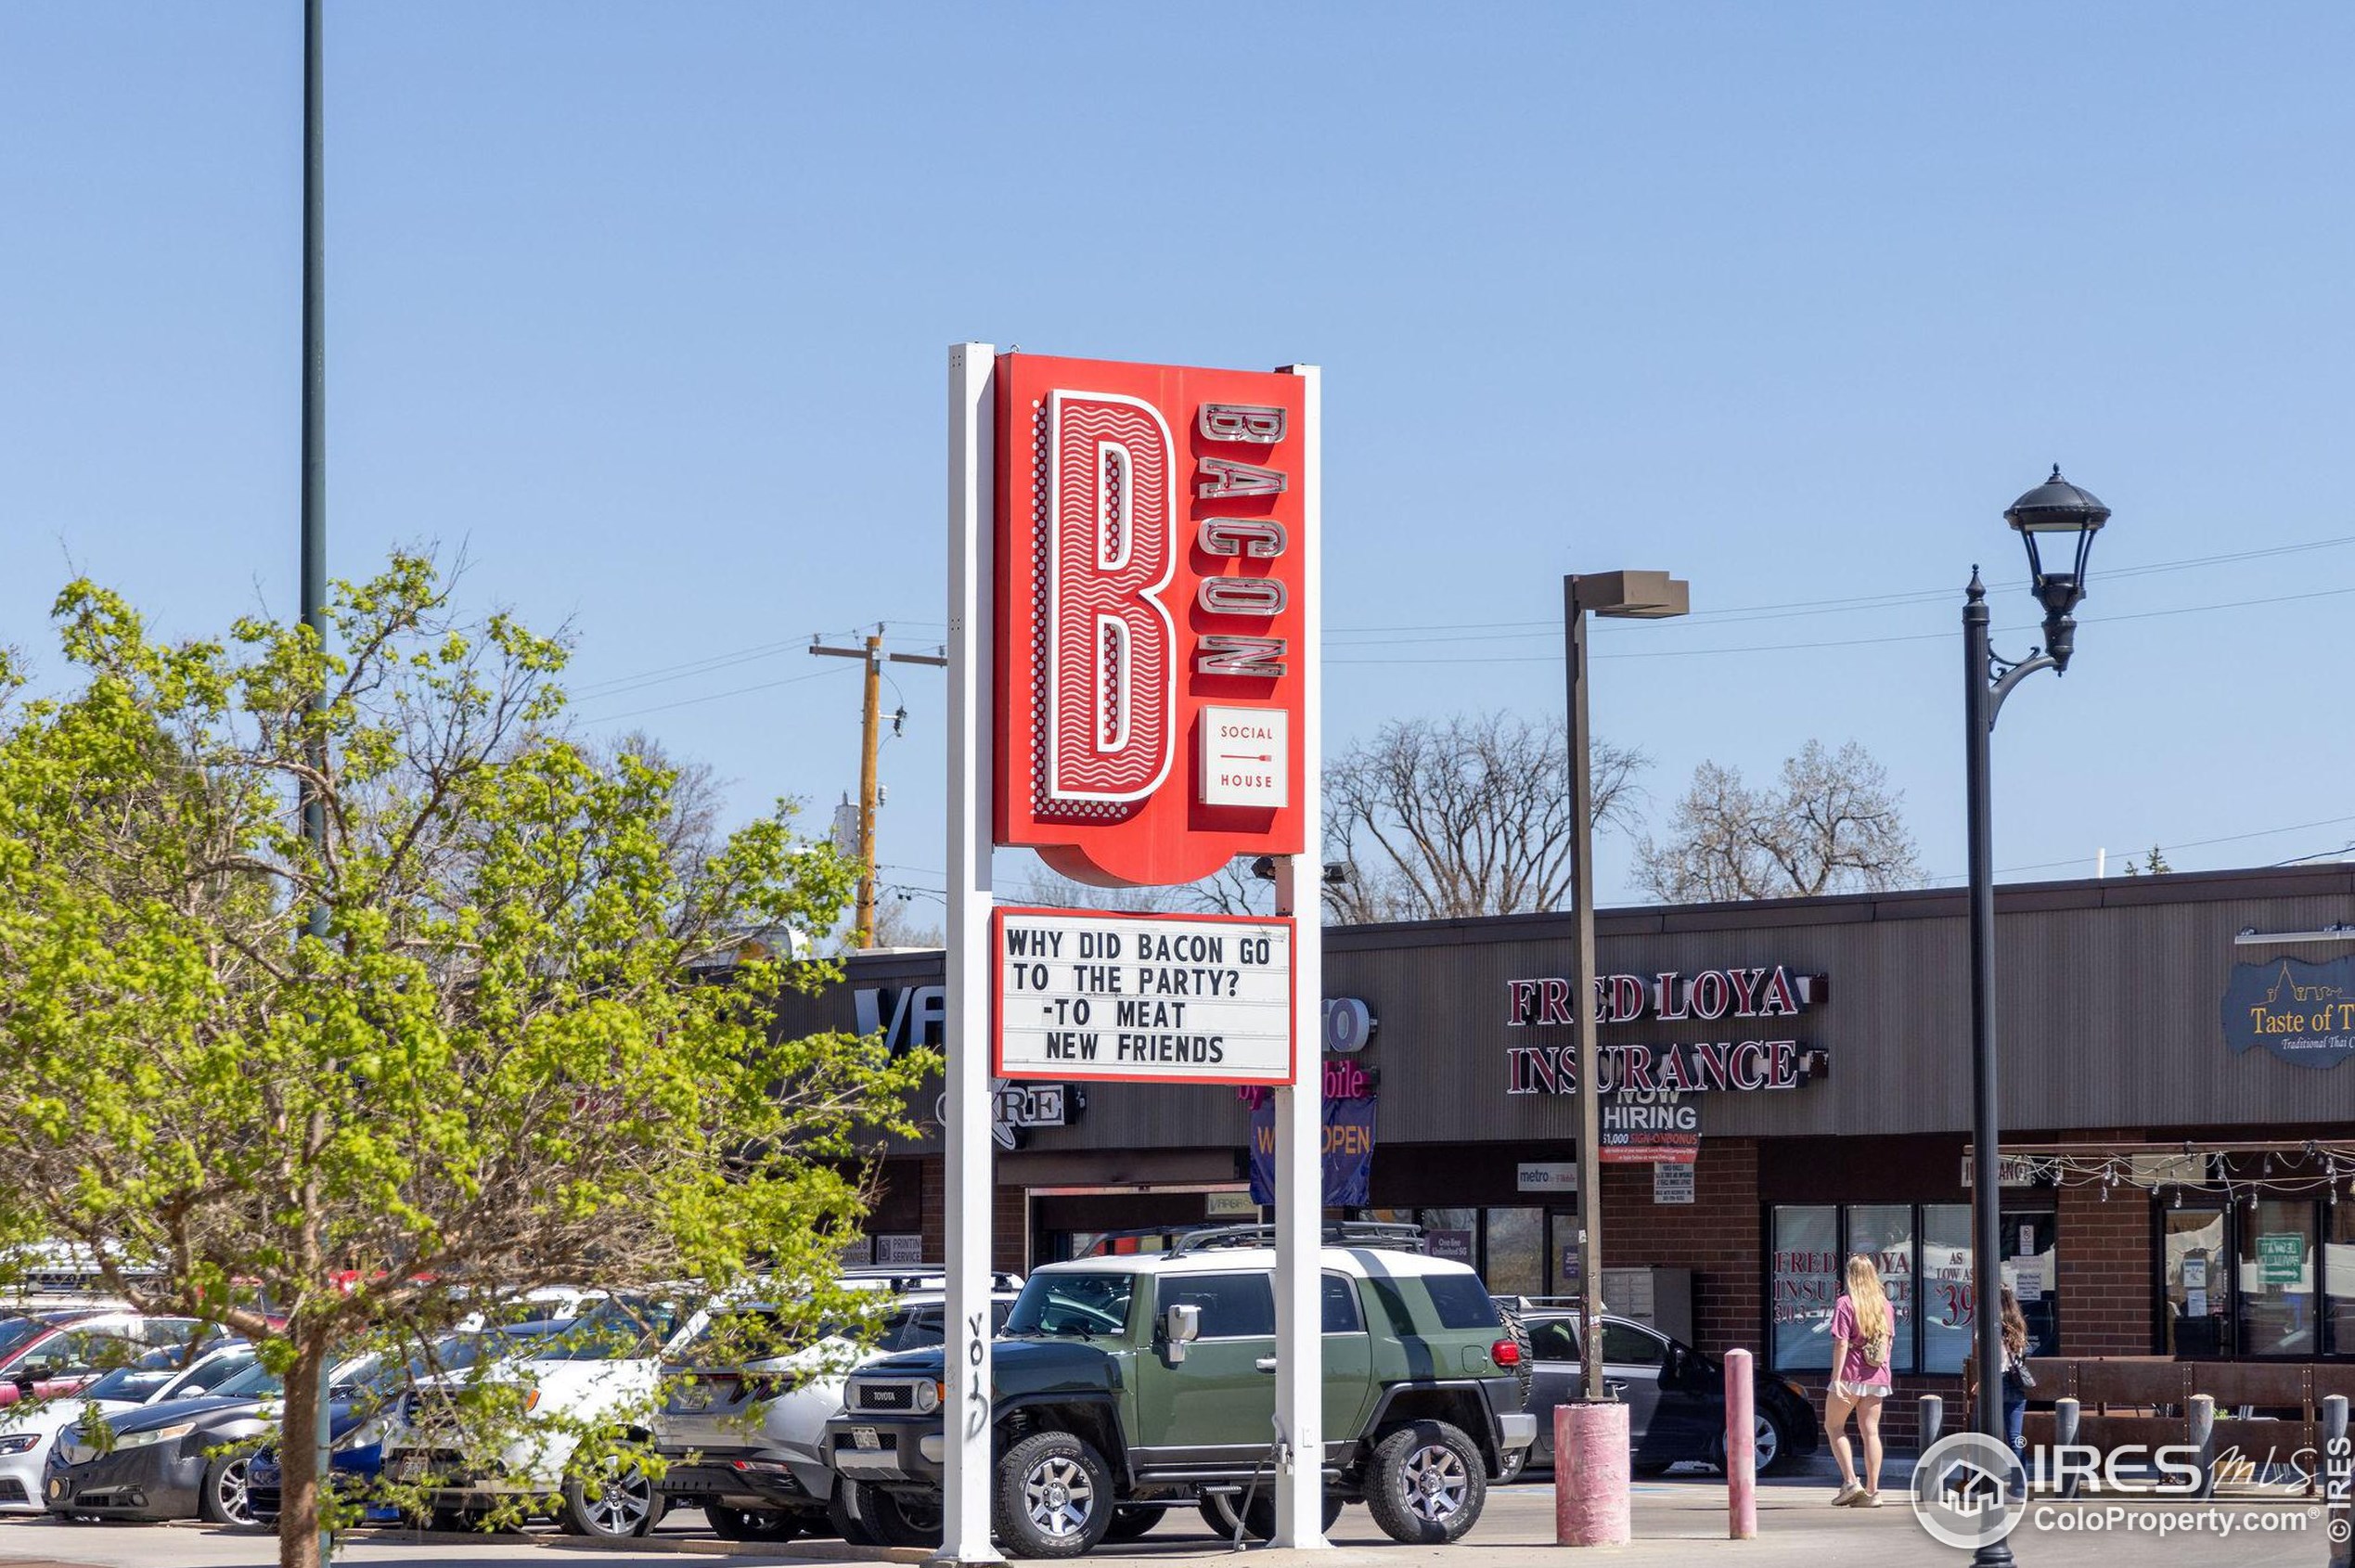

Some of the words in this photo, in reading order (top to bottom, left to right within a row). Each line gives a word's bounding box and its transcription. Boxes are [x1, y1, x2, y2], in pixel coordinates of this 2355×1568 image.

[1198, 403, 1289, 677] BACON
[1220, 725, 1274, 740] SOCIAL
[1220, 774, 1273, 789] HOUSE
[1007, 929, 1063, 958] WHY
[1079, 932, 1121, 959] DID
[1138, 934, 1223, 964] BACON
[1240, 938, 1270, 966] GO
[1013, 963, 1049, 991] TO
[1073, 964, 1122, 993] THE
[1139, 967, 1240, 997] PARTY?
[1655, 965, 1798, 1022] LOYA
[1115, 1000, 1187, 1029] MEAT
[2250, 1007, 2303, 1035] Taste
[2311, 1003, 2334, 1032] of
[1046, 1032, 1099, 1060] NEW
[1116, 1034, 1224, 1063] FRIENDS
[2282, 1036, 2328, 1050] Traditional
[2329, 1035, 2348, 1048] Thai
[1603, 1106, 1696, 1130] HIRING
[1520, 1169, 1550, 1183] metro
[1773, 1251, 1838, 1274] FRED
[1950, 1252, 1963, 1265] AS
[1936, 1266, 1961, 1280] LOW
[873, 1392, 895, 1401] TOYOTA
